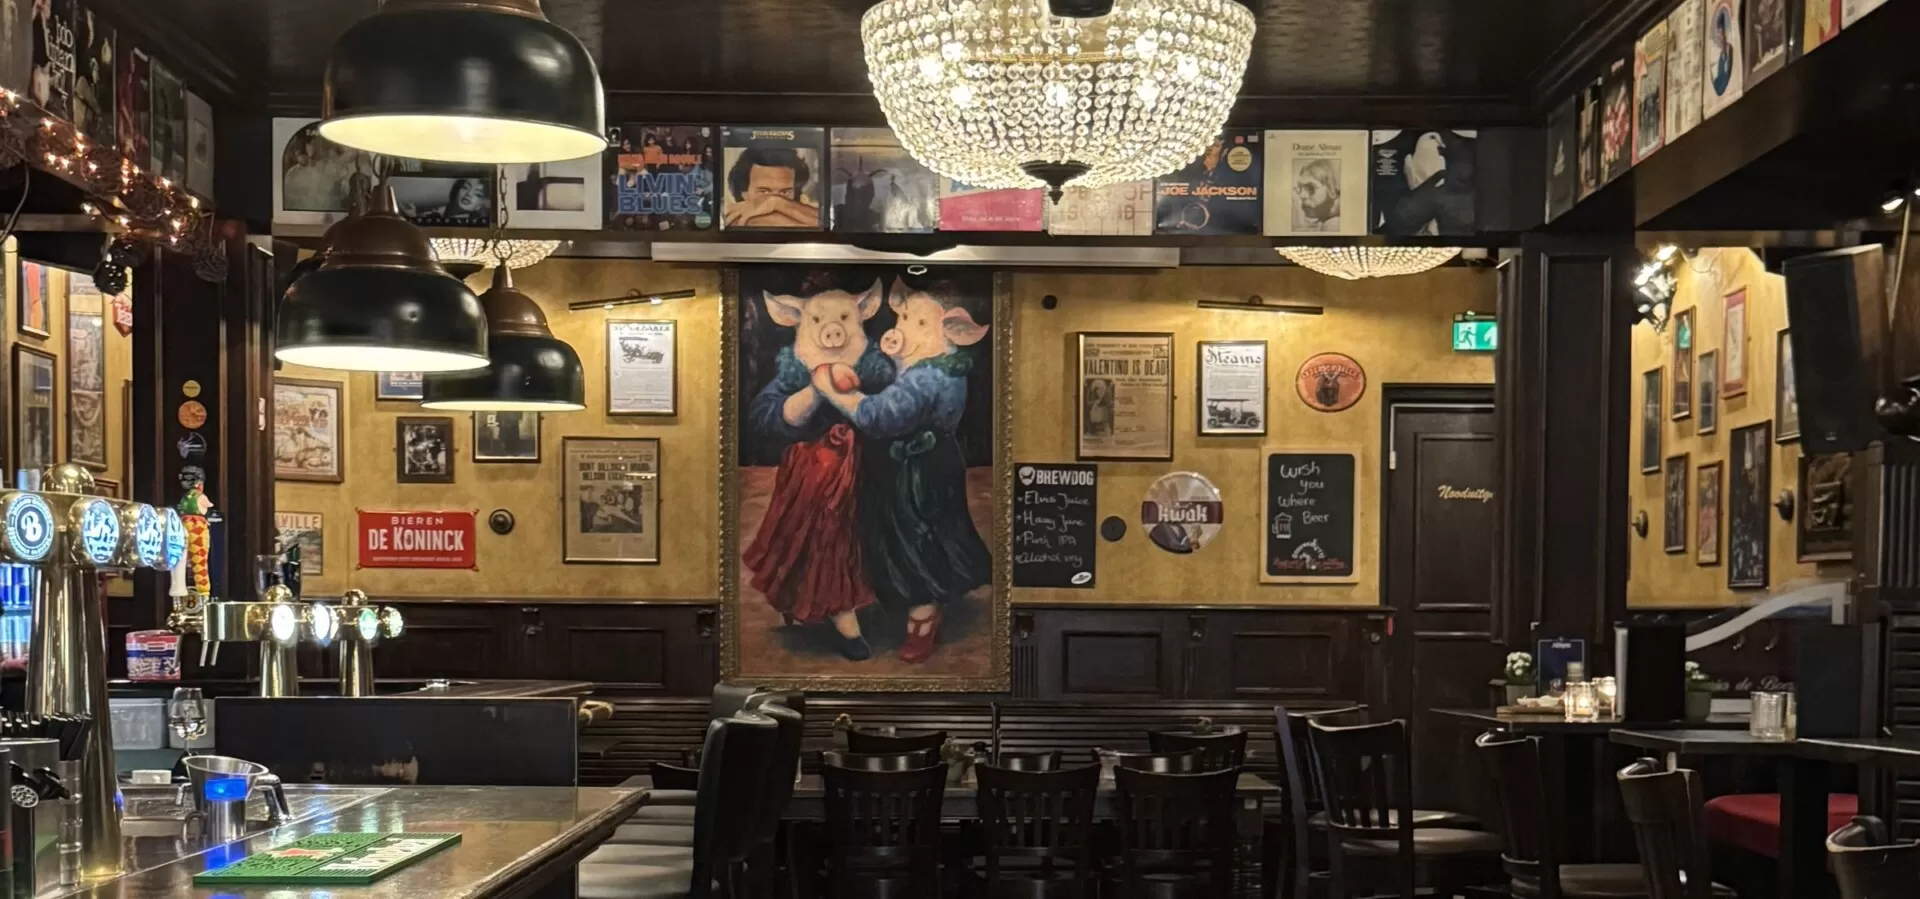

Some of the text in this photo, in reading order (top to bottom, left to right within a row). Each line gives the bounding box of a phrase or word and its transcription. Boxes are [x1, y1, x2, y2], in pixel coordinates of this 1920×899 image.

[1157, 186, 1258, 196] JOE JACKSON
[618, 194, 703, 215] BLUES
[1084, 359, 1166, 376] VALENTINO IS DEAD
[1036, 469, 1094, 486] BREWDOG
[391, 516, 444, 525] BIEREN
[1302, 510, 1330, 525] Beer
[368, 526, 465, 551] DE KONINCK
